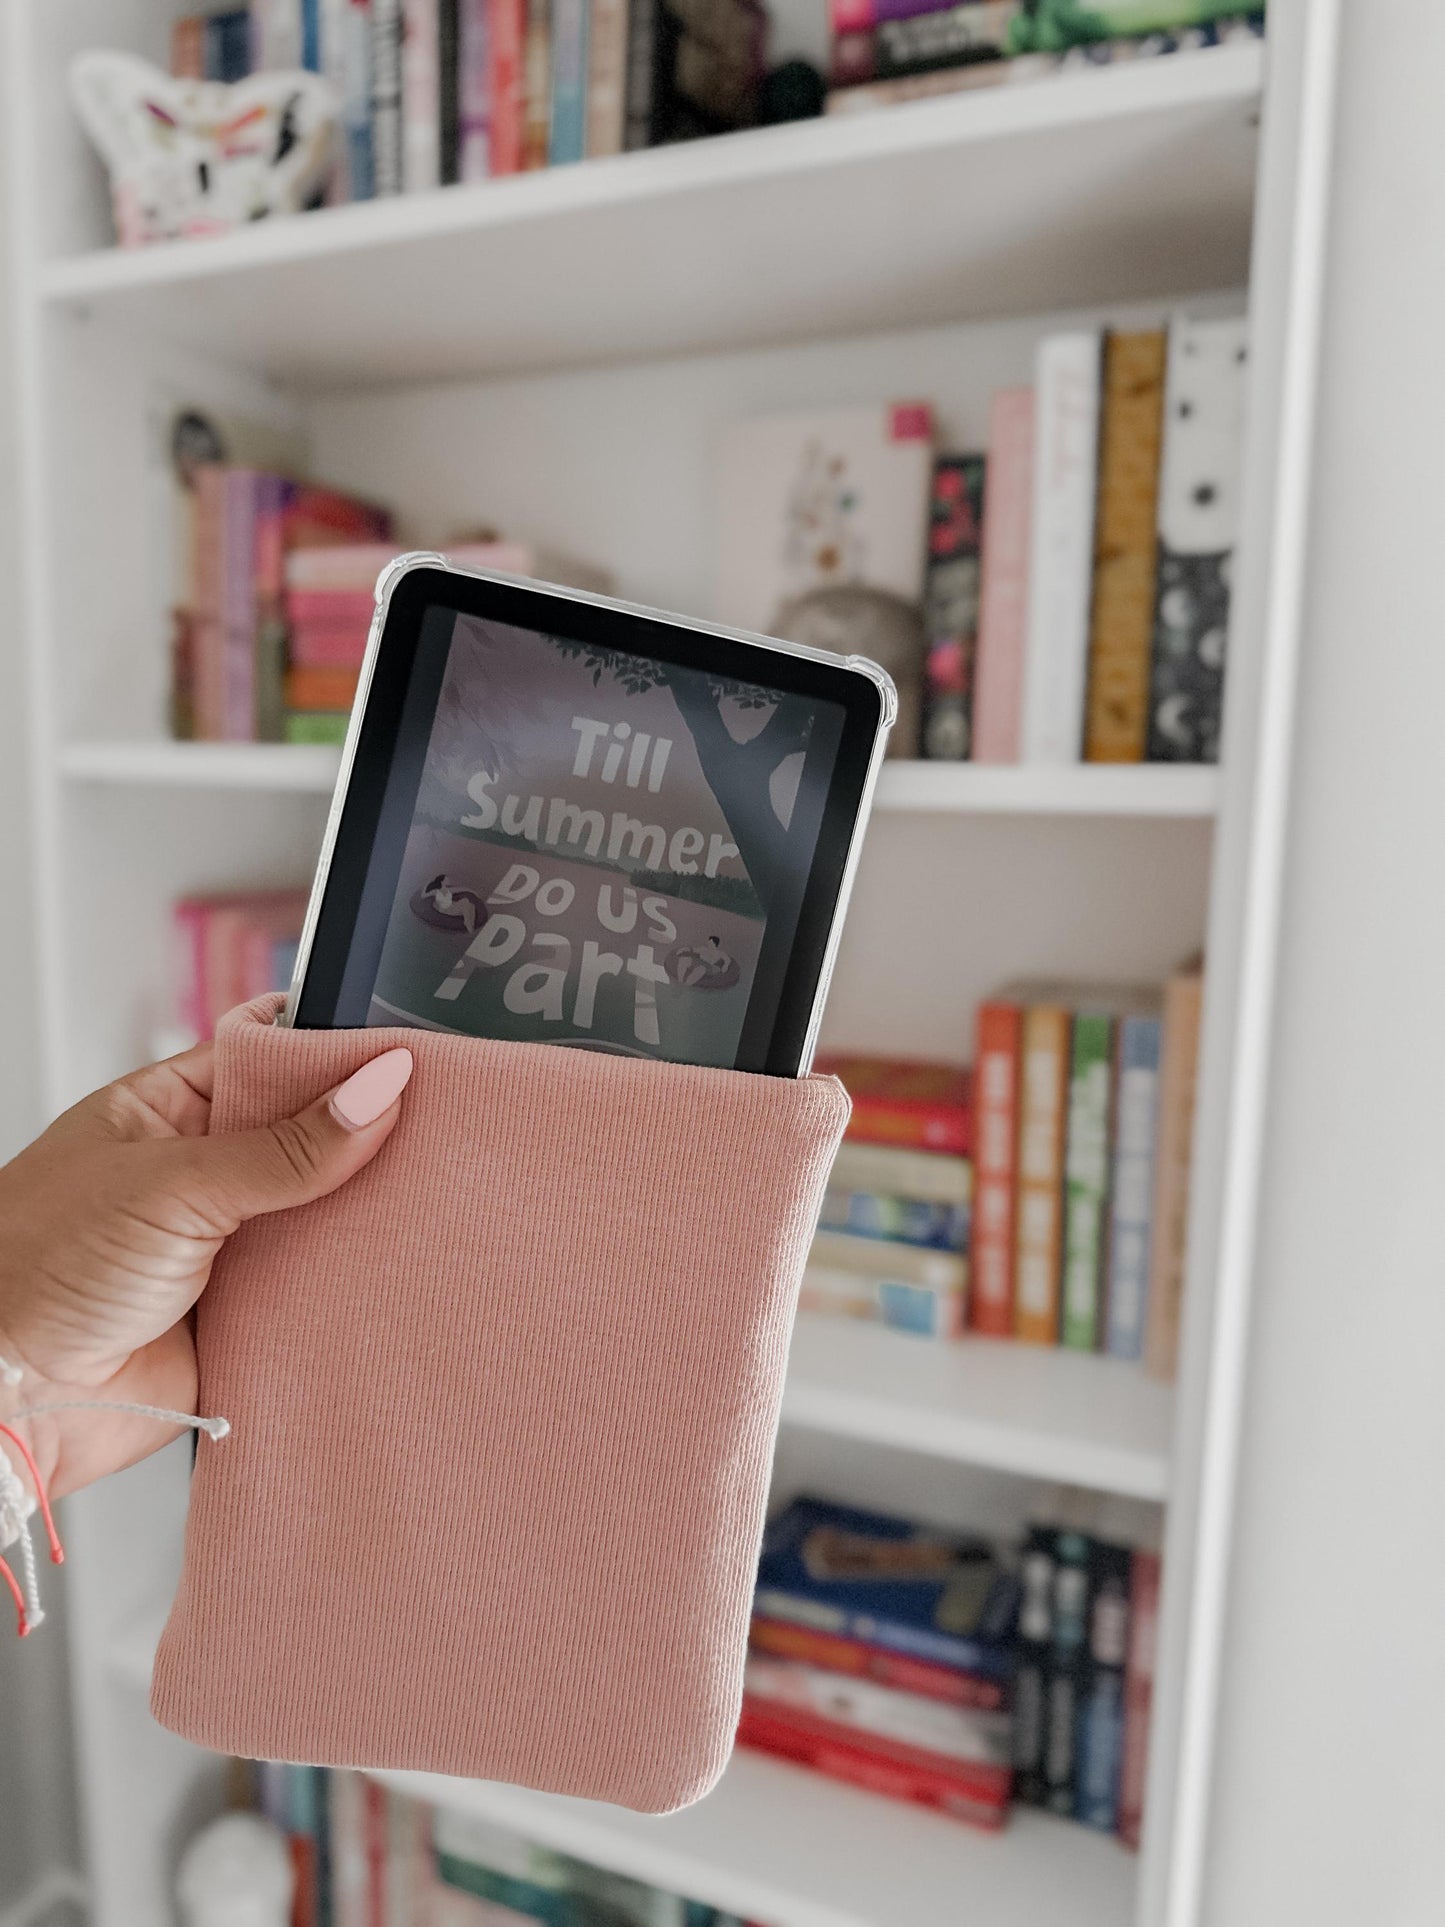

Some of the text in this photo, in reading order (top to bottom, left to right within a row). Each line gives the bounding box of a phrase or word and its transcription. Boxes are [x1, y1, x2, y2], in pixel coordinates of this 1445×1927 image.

[572, 718, 672, 792] Till
[461, 773, 739, 878] Summer
[435, 915, 670, 1044] Part
